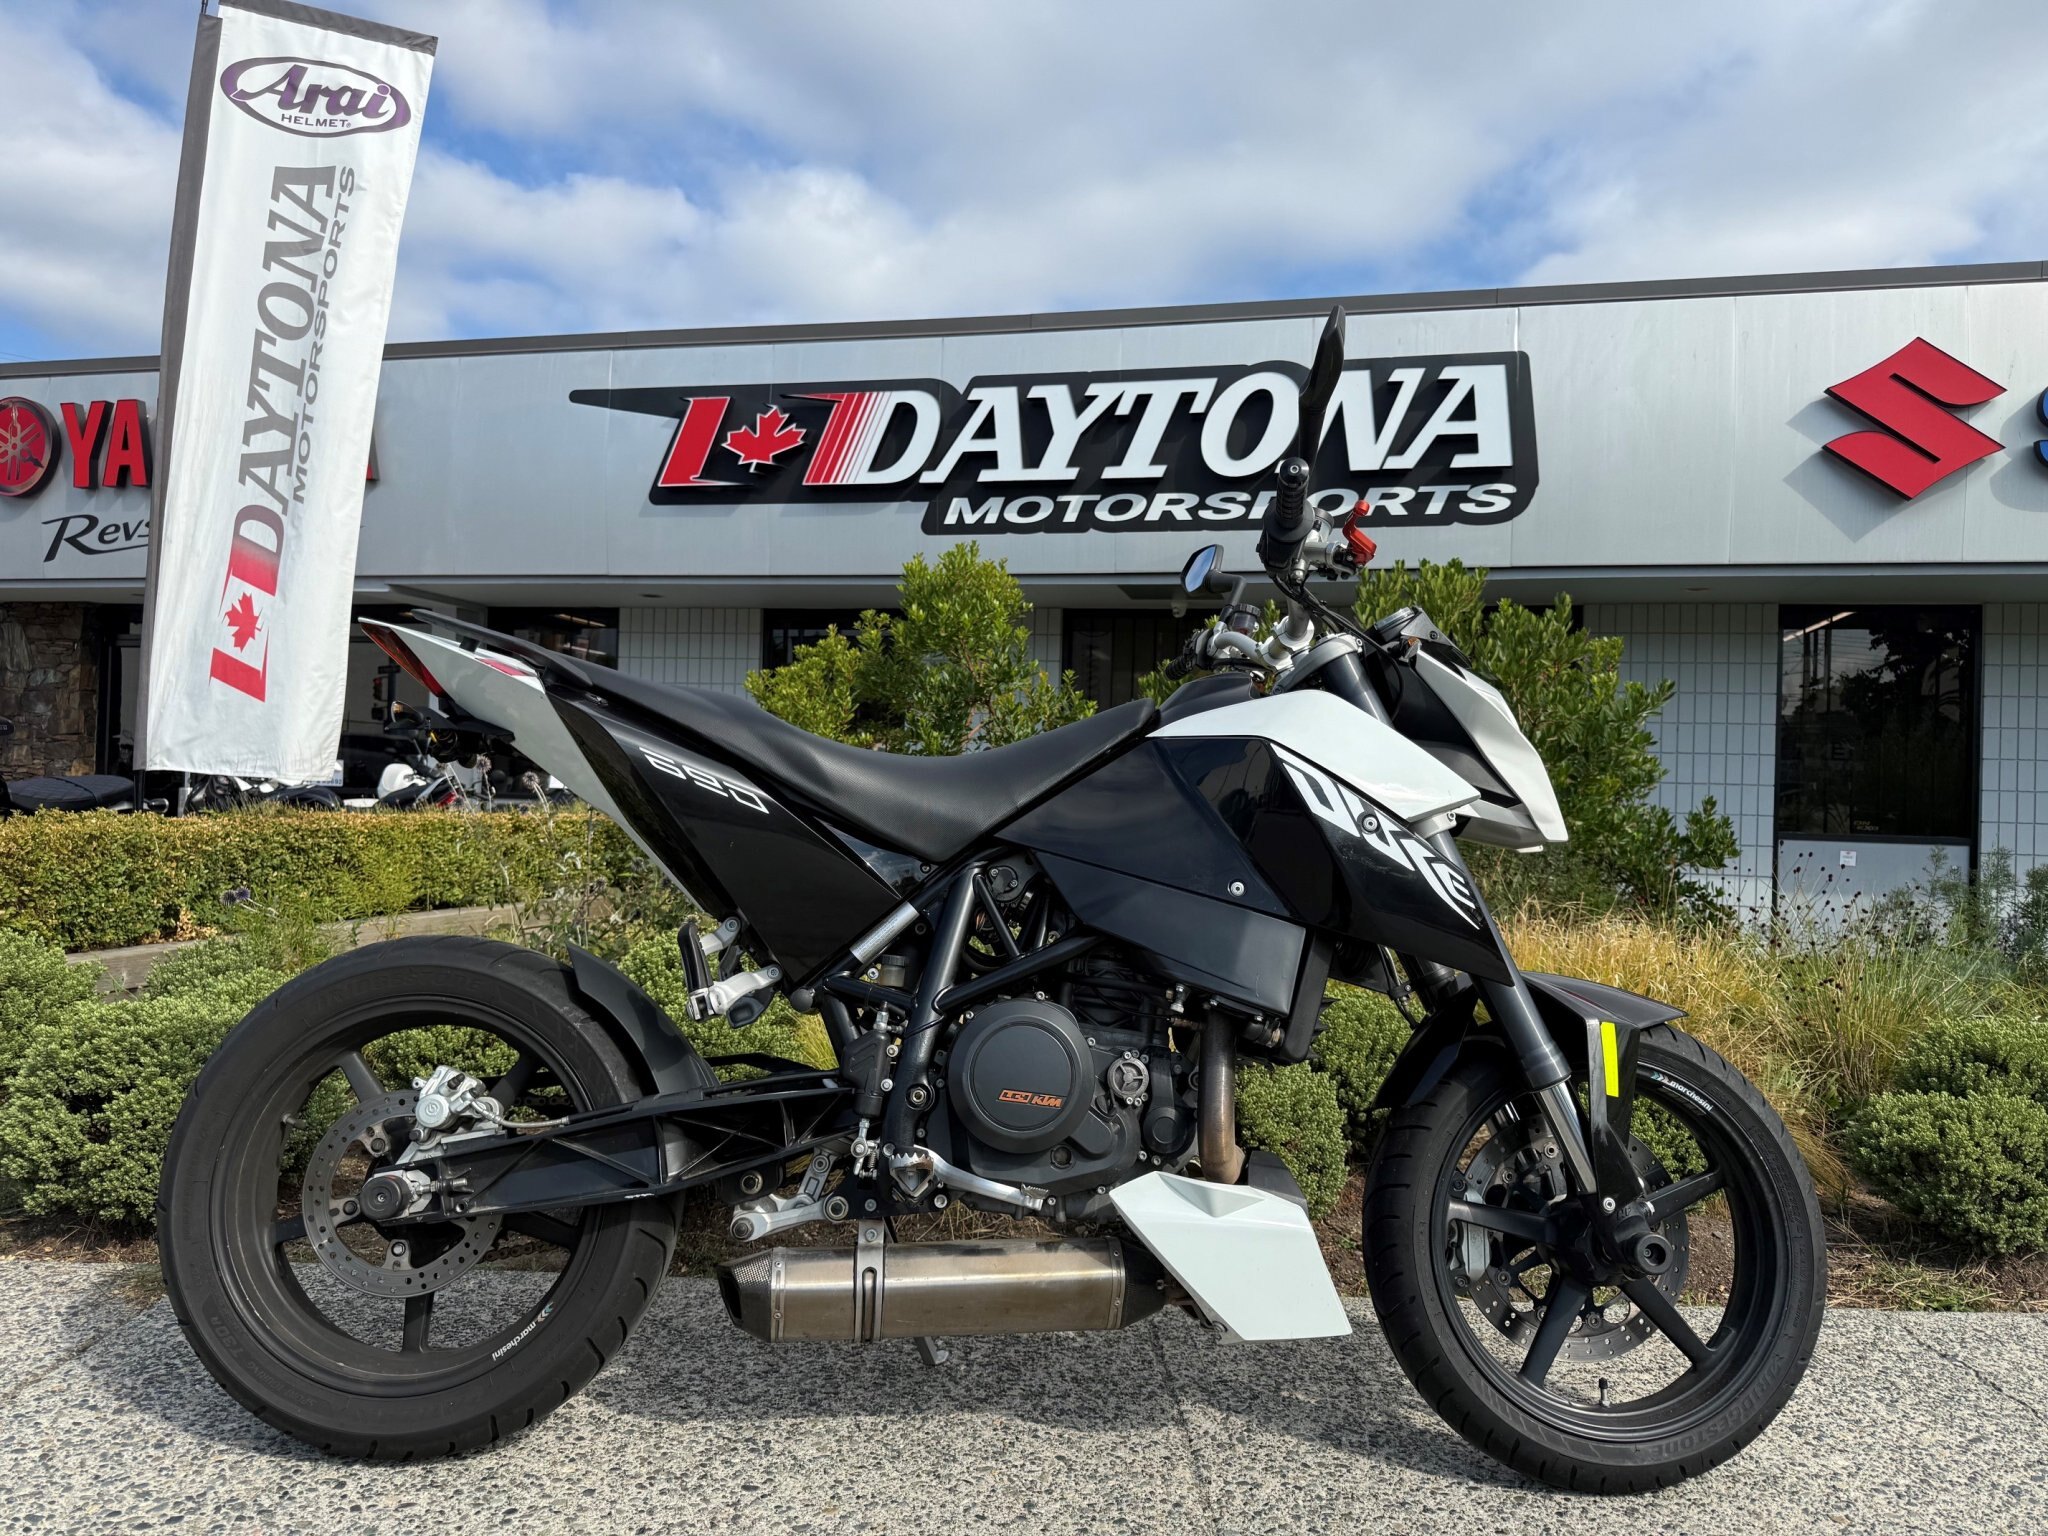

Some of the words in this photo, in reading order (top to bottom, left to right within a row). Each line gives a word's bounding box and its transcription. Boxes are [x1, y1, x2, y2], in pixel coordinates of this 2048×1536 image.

[230, 64, 391, 119] Arai
[281, 113, 349, 128] HELMET
[293, 166, 355, 504] MOTORSPORTS
[230, 165, 336, 597] DAYTONA
[802, 364, 1514, 486] DAYTONA
[639, 747, 769, 814] 690
[1270, 742, 1480, 930] DUKE
[1031, 1095, 1062, 1107] KTM
[1669, 1080, 1714, 1112] marchesini
[491, 1321, 536, 1361] marchesini
